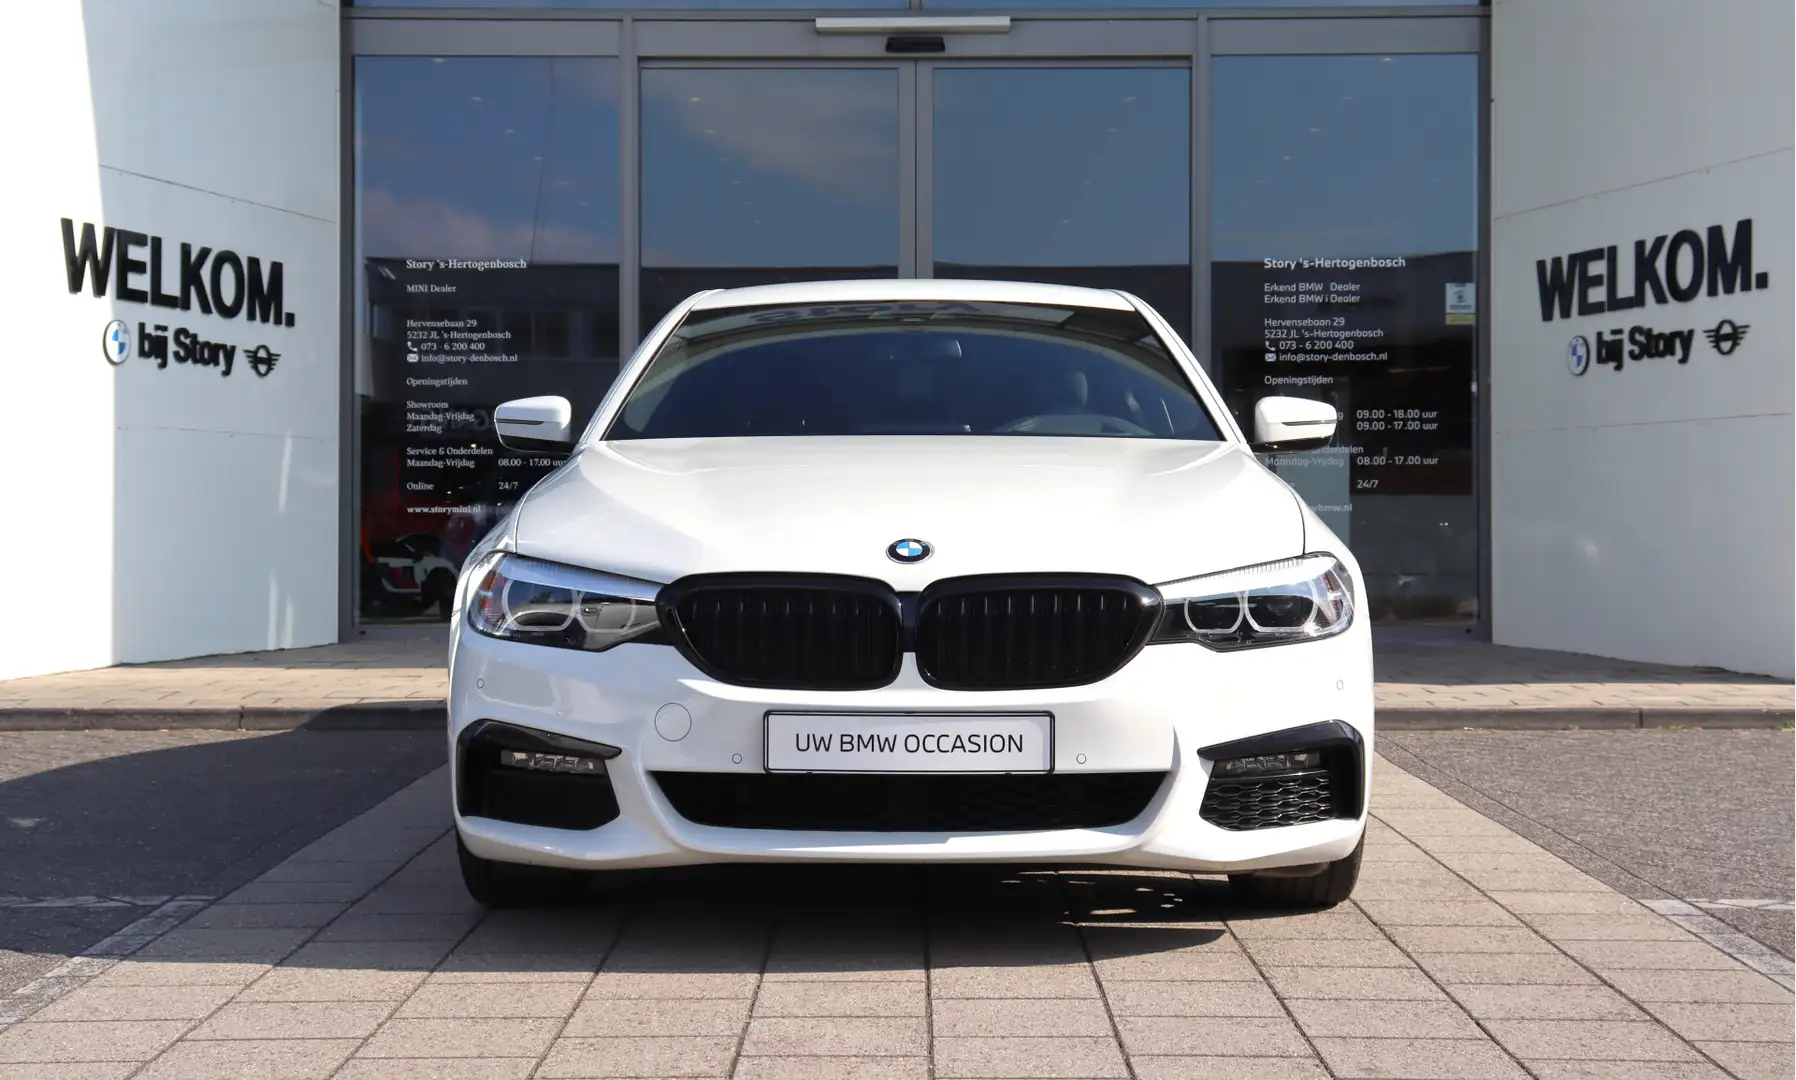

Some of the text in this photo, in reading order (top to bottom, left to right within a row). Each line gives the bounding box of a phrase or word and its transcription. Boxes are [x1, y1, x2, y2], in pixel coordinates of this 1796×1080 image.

[406, 259, 527, 271] Story 's-Hertogenbosch
[1264, 257, 1406, 269] Story 's-Hertogenbosch
[61, 218, 295, 327] WELKOM.
[1536, 218, 1769, 322] WELKOM.
[430, 284, 456, 292] Dealer
[1264, 283, 1360, 291] Erkend BMW Dealer
[1264, 294, 1296, 303] Erkend
[1299, 294, 1323, 303] BMW
[1331, 294, 1360, 302] Dealer
[407, 319, 464, 327] Hervensebaan
[1264, 317, 1345, 326] Hervensebaan 29
[407, 331, 511, 340] 5232 JL 's-Hertogenbosch
[1264, 329, 1383, 339] 5232 JL 's-Hertogenbosch
[138, 322, 236, 377] bij Story
[421, 342, 437, 350] 073
[444, 342, 449, 350] 6
[452, 342, 467, 350] 200
[469, 342, 485, 350] 400
[1279, 341, 1297, 350] 073
[1305, 341, 1311, 349] 6
[1313, 341, 1333, 349] 200
[1335, 341, 1354, 349] 400
[1596, 326, 1695, 371] bij Story
[421, 354, 517, 364] info@story-denbosch.nl
[1279, 352, 1387, 363] info@story-denbosch.nl
[407, 377, 468, 387] Openingstijden
[1264, 375, 1333, 385] Openingstijden
[407, 401, 448, 409] Showroom
[407, 412, 474, 422] Maandag-Vrijdag
[1357, 410, 1385, 419] 09.00
[1394, 410, 1420, 419] 18.00
[407, 424, 442, 433] Zaterdag
[1357, 422, 1385, 430] 09.00
[1394, 421, 1420, 430] 17.00
[407, 447, 436, 455] Service
[447, 447, 493, 455] Onderdelen
[407, 459, 475, 468] Maandag-Vrijdag
[498, 458, 521, 466] 08.00
[529, 458, 550, 466] 17.00
[1265, 456, 1343, 467] Maandag-Vrijdag
[1357, 456, 1385, 465] 08.00
[1395, 456, 1421, 465] 17.00
[407, 482, 518, 490] Online 24/7
[1357, 480, 1378, 489] 24/7
[407, 505, 481, 515] www.storymini.nl
[796, 733, 1023, 753] UW BMW OCCASION
